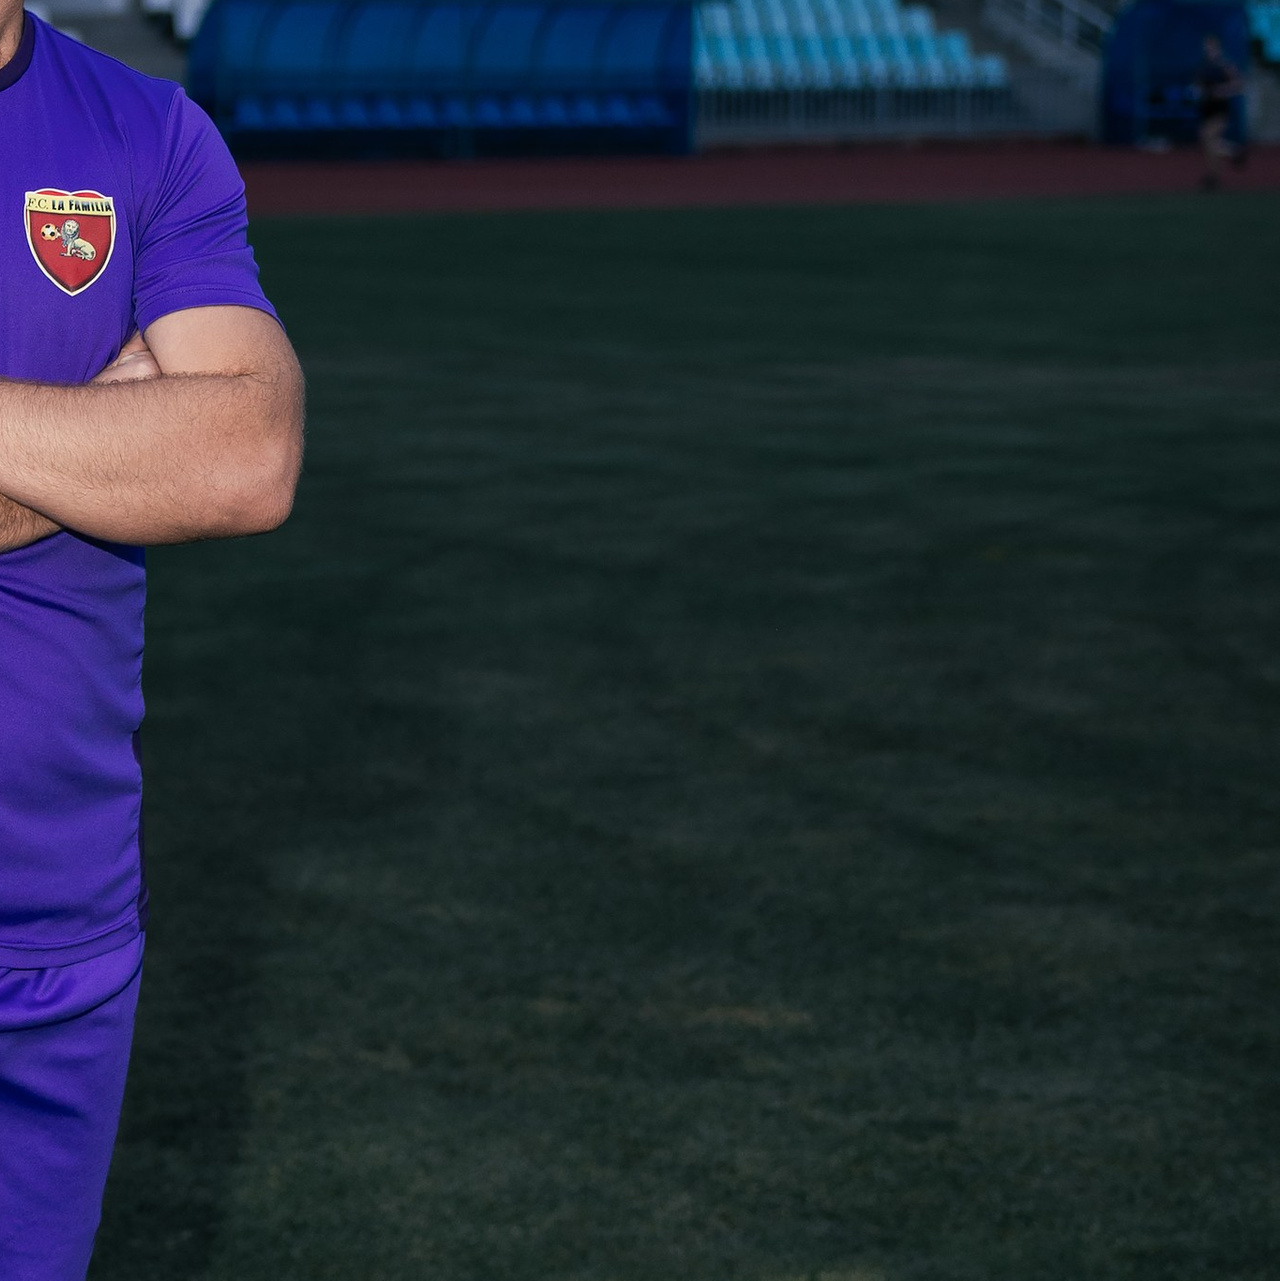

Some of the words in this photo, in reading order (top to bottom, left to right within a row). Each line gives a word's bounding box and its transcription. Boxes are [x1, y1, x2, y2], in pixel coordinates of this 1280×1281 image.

[27, 197, 49, 210] F.C.
[52, 200, 65, 211] LA
[69, 199, 112, 212] FAMILIA
